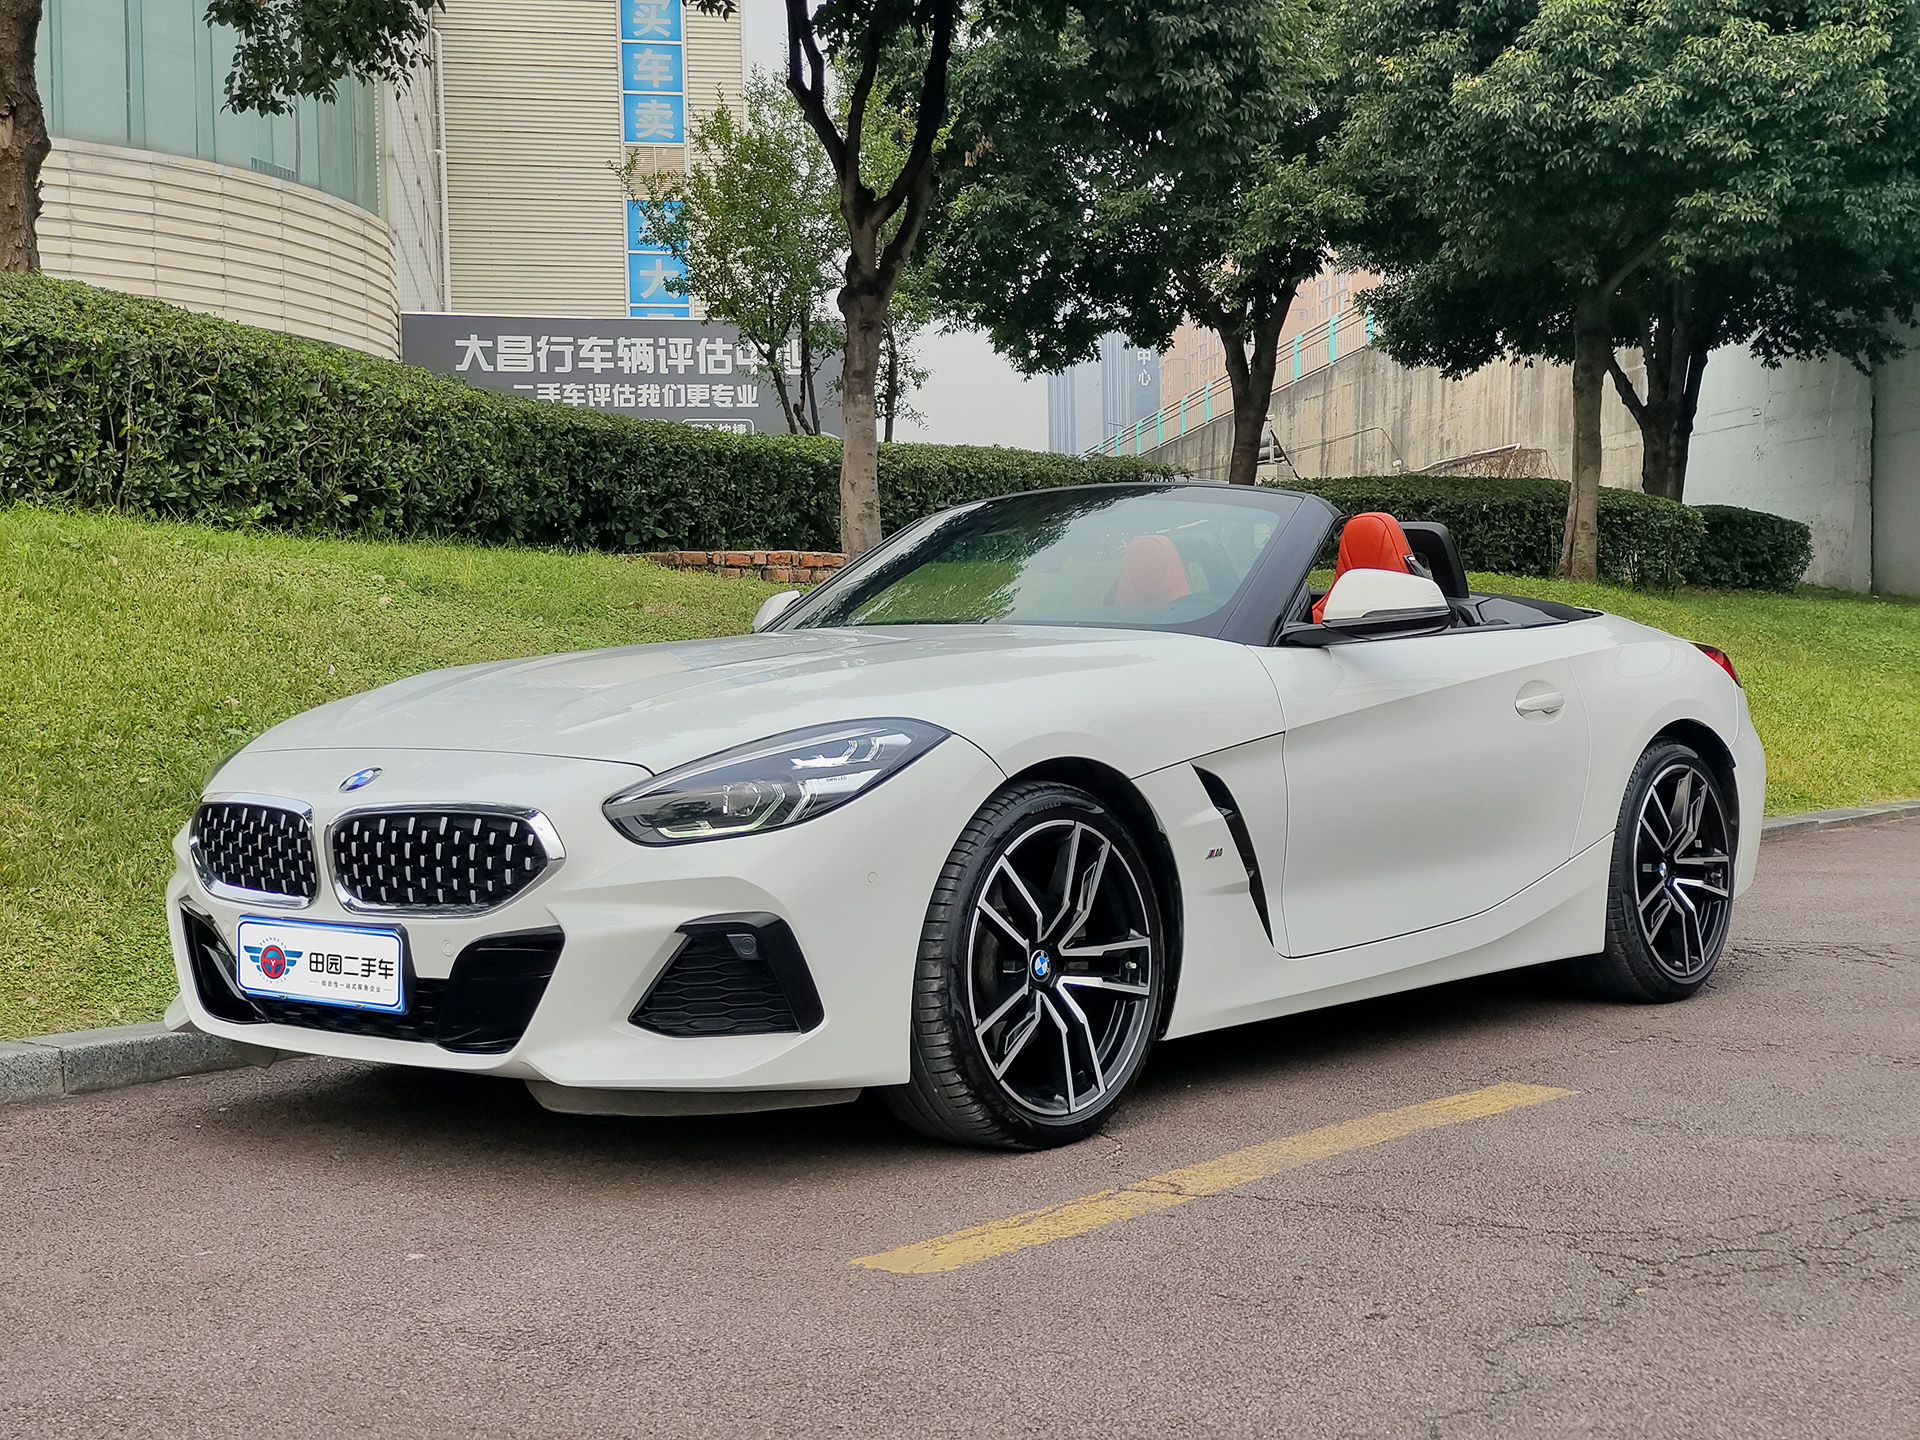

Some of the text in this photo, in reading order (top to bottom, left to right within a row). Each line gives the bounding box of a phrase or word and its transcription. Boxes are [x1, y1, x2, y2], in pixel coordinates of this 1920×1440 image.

[632, 0, 676, 139] 买车卖
[309, 952, 394, 980] 田园二手车
